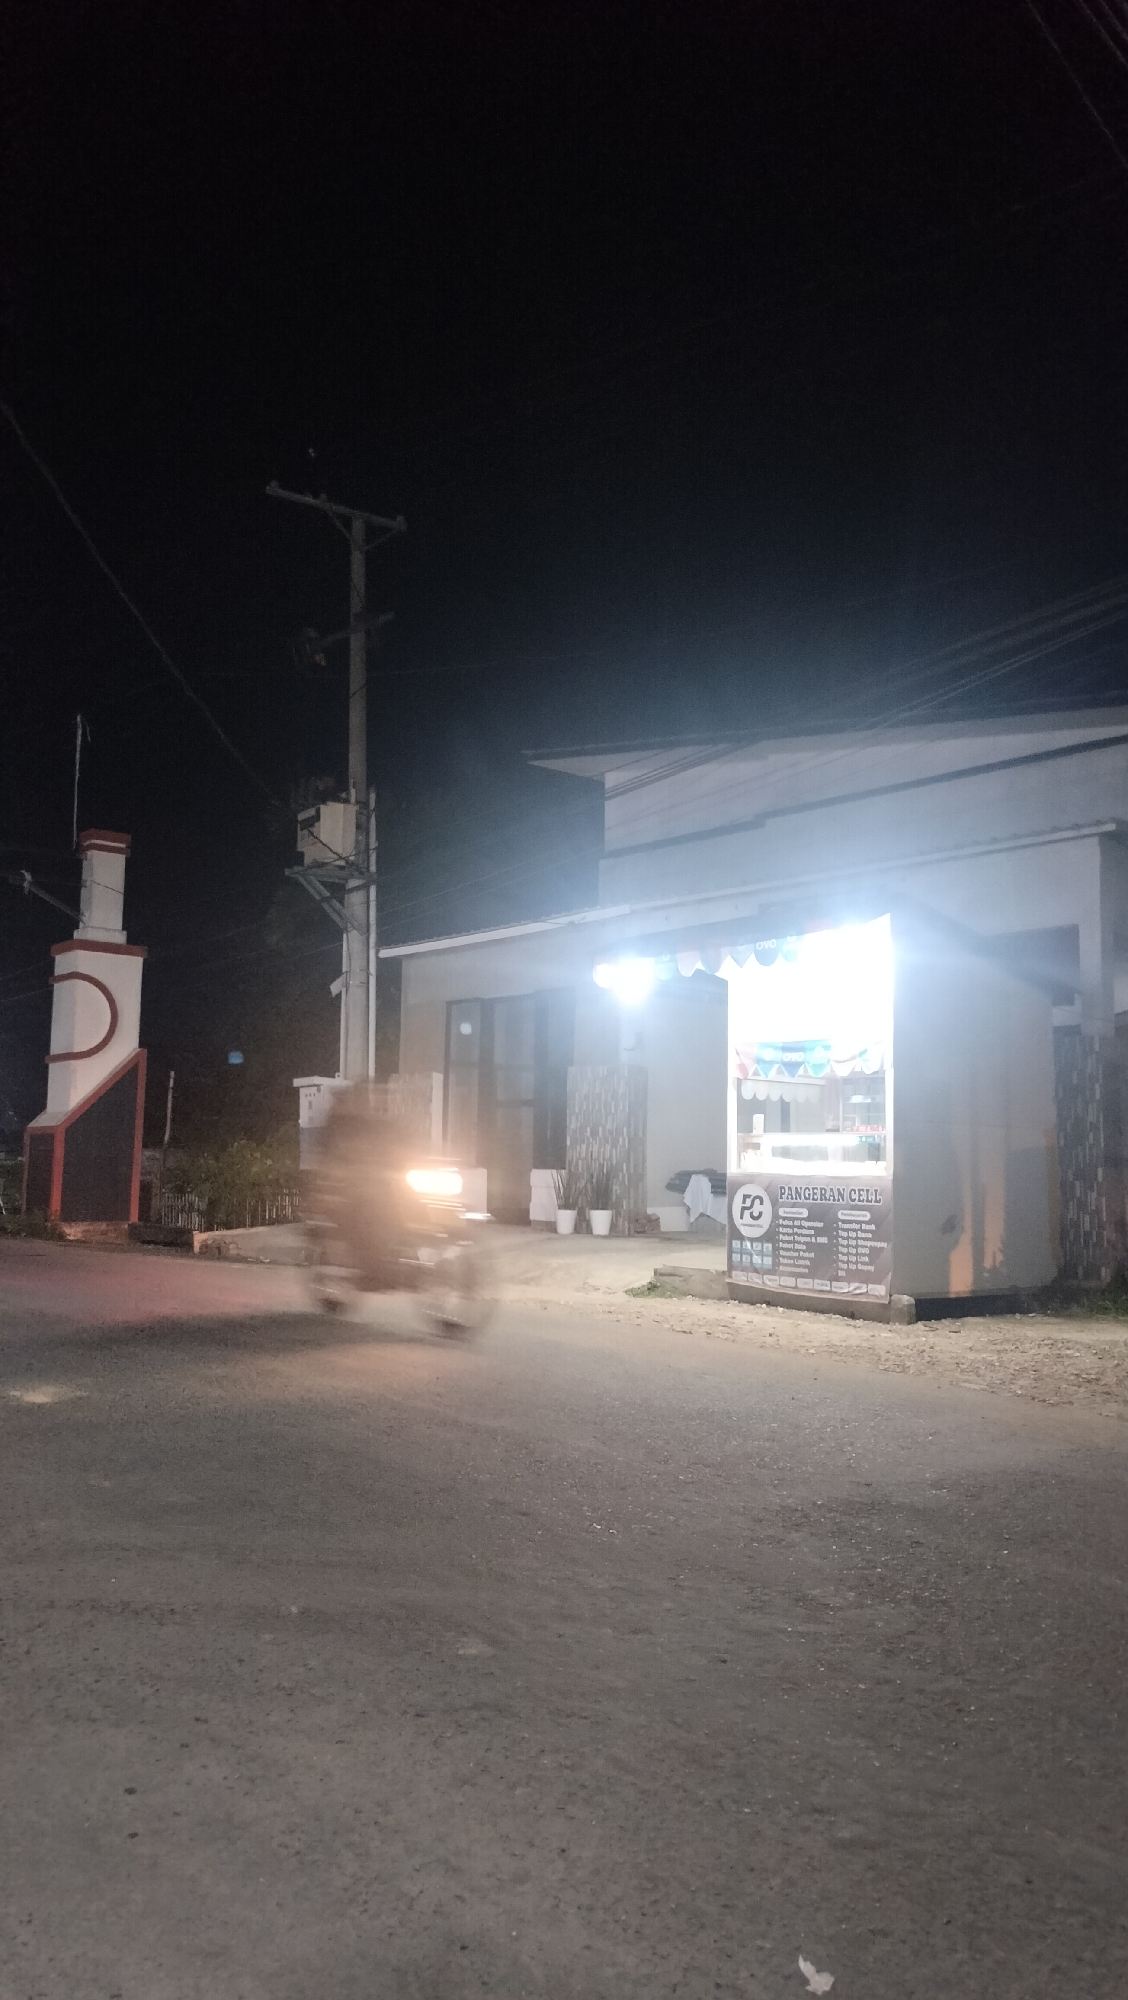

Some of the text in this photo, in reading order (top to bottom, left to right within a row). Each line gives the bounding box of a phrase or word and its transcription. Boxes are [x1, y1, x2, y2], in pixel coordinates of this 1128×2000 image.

[756, 938, 777, 950] OVO
[783, 1052, 805, 1062] OVO
[779, 1185, 882, 1204] PANGERAN CELL
[801, 1220, 824, 1228] Operator
[838, 1222, 861, 1230] Transfer
[779, 1234, 794, 1242] Paket
[838, 1230, 848, 1238] Top
[849, 1231, 857, 1239] Up
[838, 1238, 848, 1246] Top
[779, 1249, 799, 1257] Voucher
[838, 1246, 848, 1254] Top
[838, 1254, 848, 1262] Top
[838, 1262, 848, 1270] Top
